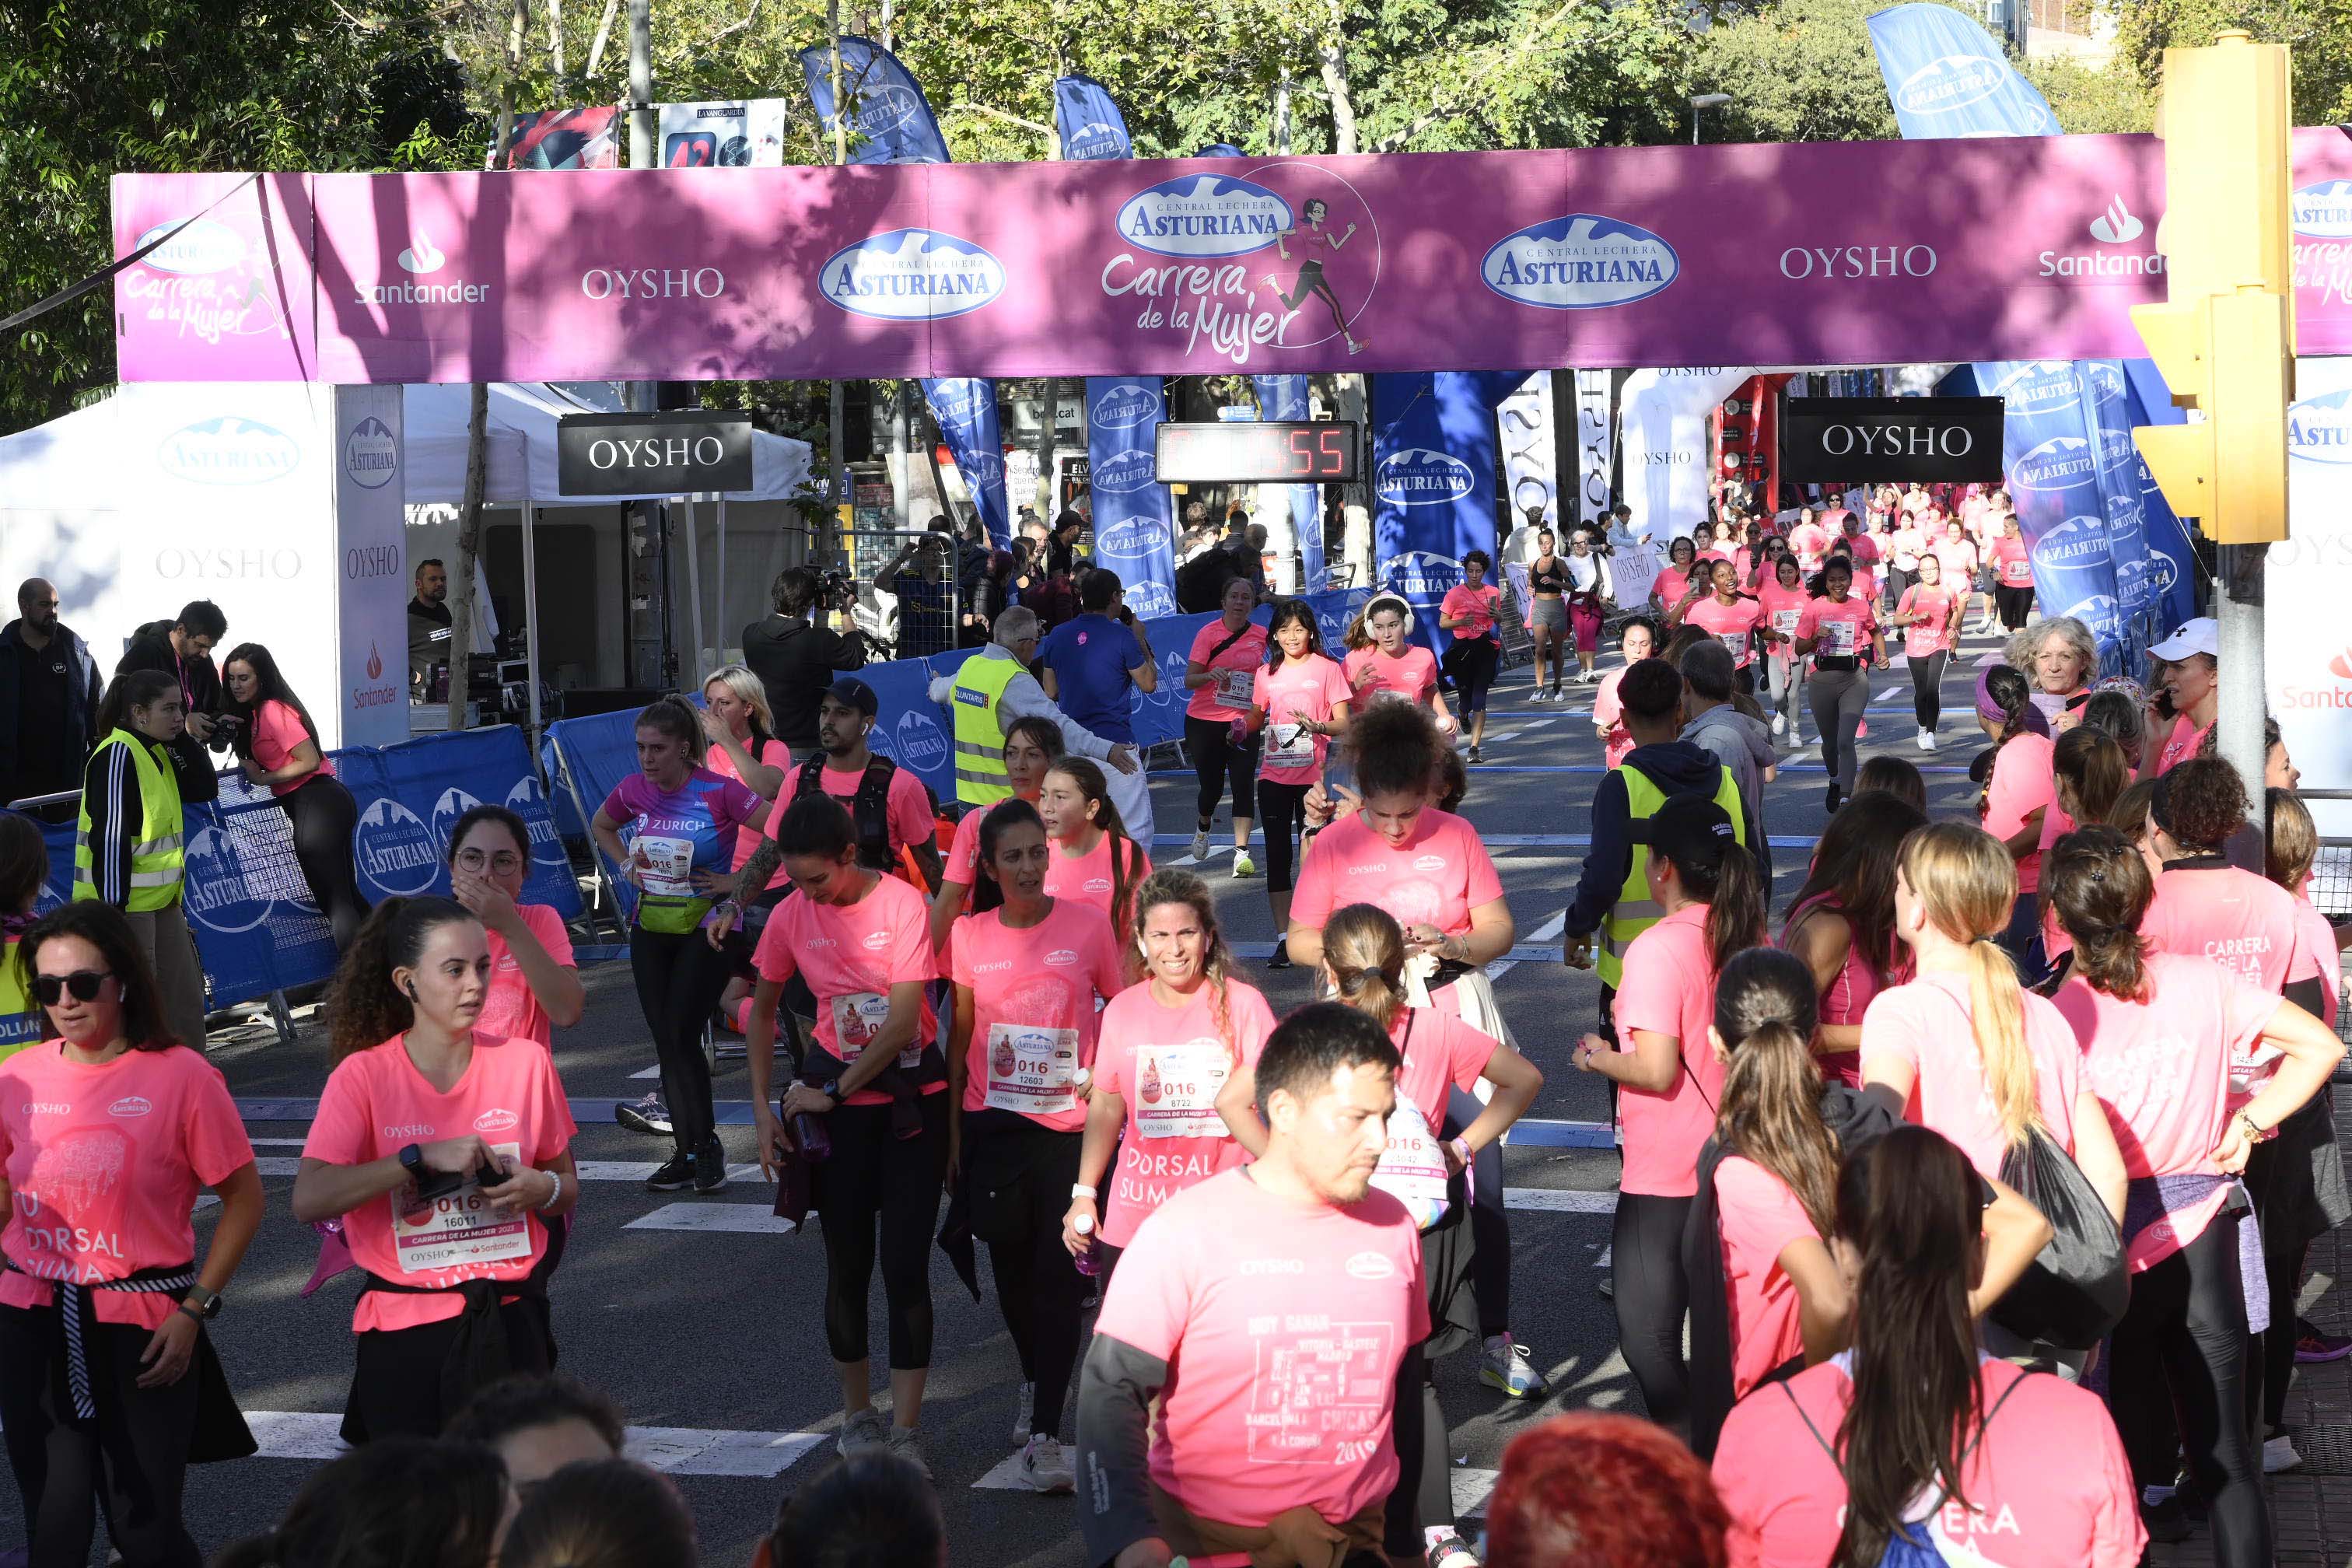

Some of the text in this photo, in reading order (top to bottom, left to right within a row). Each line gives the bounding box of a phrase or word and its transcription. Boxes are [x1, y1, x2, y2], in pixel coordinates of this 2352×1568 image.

[1157, 201, 1274, 211] CENTRAL LECHERA
[1130, 205, 1279, 236] ASTURIANA
[1527, 246, 1657, 257] CENTRAL LECHERA
[1779, 244, 1937, 279] OYSHO
[859, 258, 985, 270] CENTRAL LECHERA
[1101, 254, 1247, 296] Carrera
[1496, 250, 1664, 285] ASTURIANA
[2039, 250, 2168, 277] Santand
[124, 270, 218, 299] Carrera
[582, 267, 725, 299] OYSHO
[833, 262, 990, 297] ASTURIANA
[355, 279, 490, 305] Santander
[178, 299, 252, 345] Mujer
[1137, 292, 1302, 365] de la Mujer
[1822, 425, 1973, 457] OYSHO
[348, 446, 394, 471] ASTURIANA
[589, 436, 724, 470] OYSHO
[1379, 474, 1467, 494] ASTURIANA
[156, 546, 303, 579] OYSHO
[347, 544, 399, 579] OYSHO
[1426, 569, 1464, 577] LECHERA
[1616, 553, 1650, 583] OYSHO
[354, 683, 397, 710] Santander
[652, 818, 706, 831] ZURICH
[364, 837, 436, 876] ASTURIANA
[652, 859, 672, 869] 016
[1348, 863, 1387, 876] OYSHO
[2204, 935, 2272, 958] CARRERA
[974, 961, 1012, 974] OYSHO
[2242, 956, 2262, 972] LA
[1017, 1040, 1052, 1050] ASTURIANA
[1017, 1059, 1048, 1074] 016
[1020, 1076, 1044, 1085] 12603
[1164, 1083, 1195, 1096] 016
[23, 1102, 71, 1116] OYSHO
[994, 1095, 1020, 1104] OYSHO
[1171, 1099, 1192, 1108] 8722
[383, 1124, 436, 1139] OYSHO
[1144, 1123, 1173, 1132] OYSHO
[1126, 1147, 1213, 1177] DORSAL
[13, 1190, 39, 1218] TU
[437, 1194, 481, 1213] 016
[444, 1216, 478, 1228] 16011
[25, 1227, 124, 1259] DORSAL
[412, 1234, 447, 1244] CARRERA
[471, 1228, 496, 1237] MUJER
[498, 1226, 516, 1234] 2023
[410, 1241, 520, 1263] OYSHO Santander
[1334, 1440, 1377, 1465] 2019
